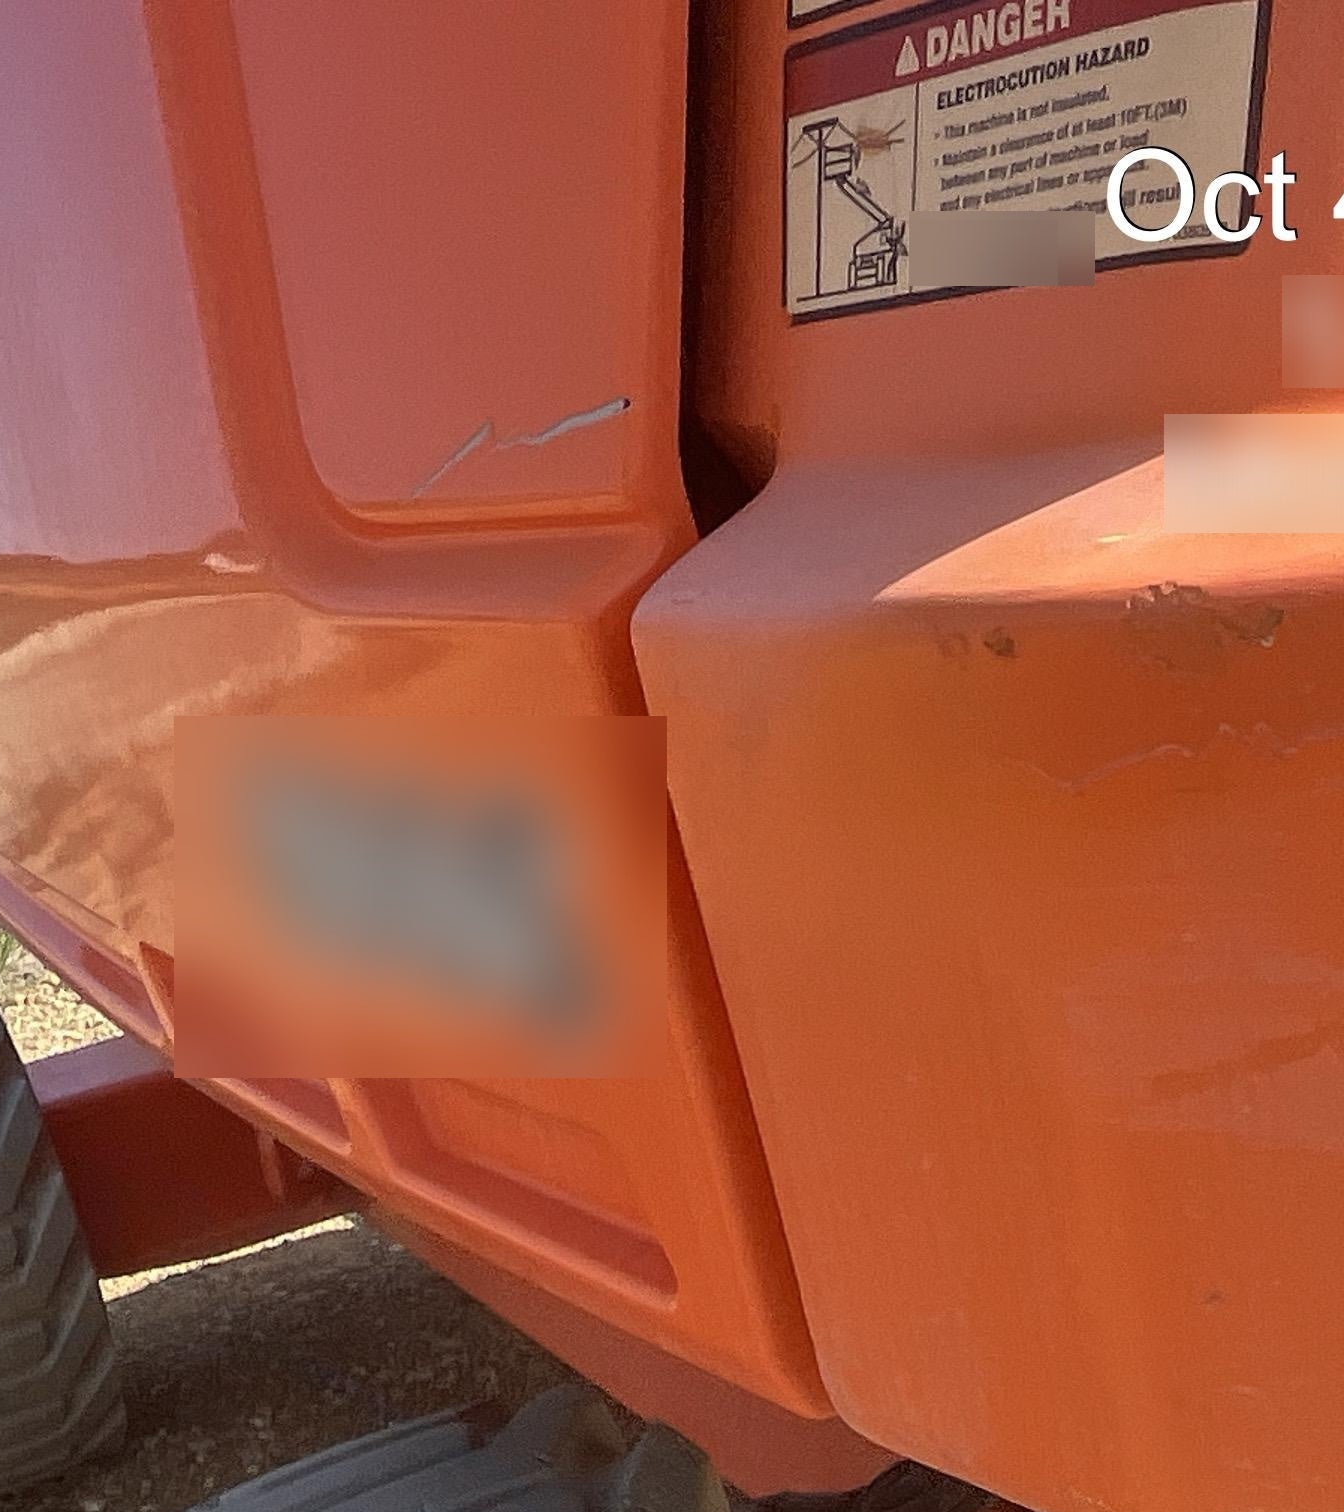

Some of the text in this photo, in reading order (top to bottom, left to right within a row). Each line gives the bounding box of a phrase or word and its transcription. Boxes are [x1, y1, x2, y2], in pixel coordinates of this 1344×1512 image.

[926, 0, 1072, 68] DANGER
[937, 36, 1150, 110] ELECTROCUTION HAZARD
[1138, 181, 1181, 205] resul
